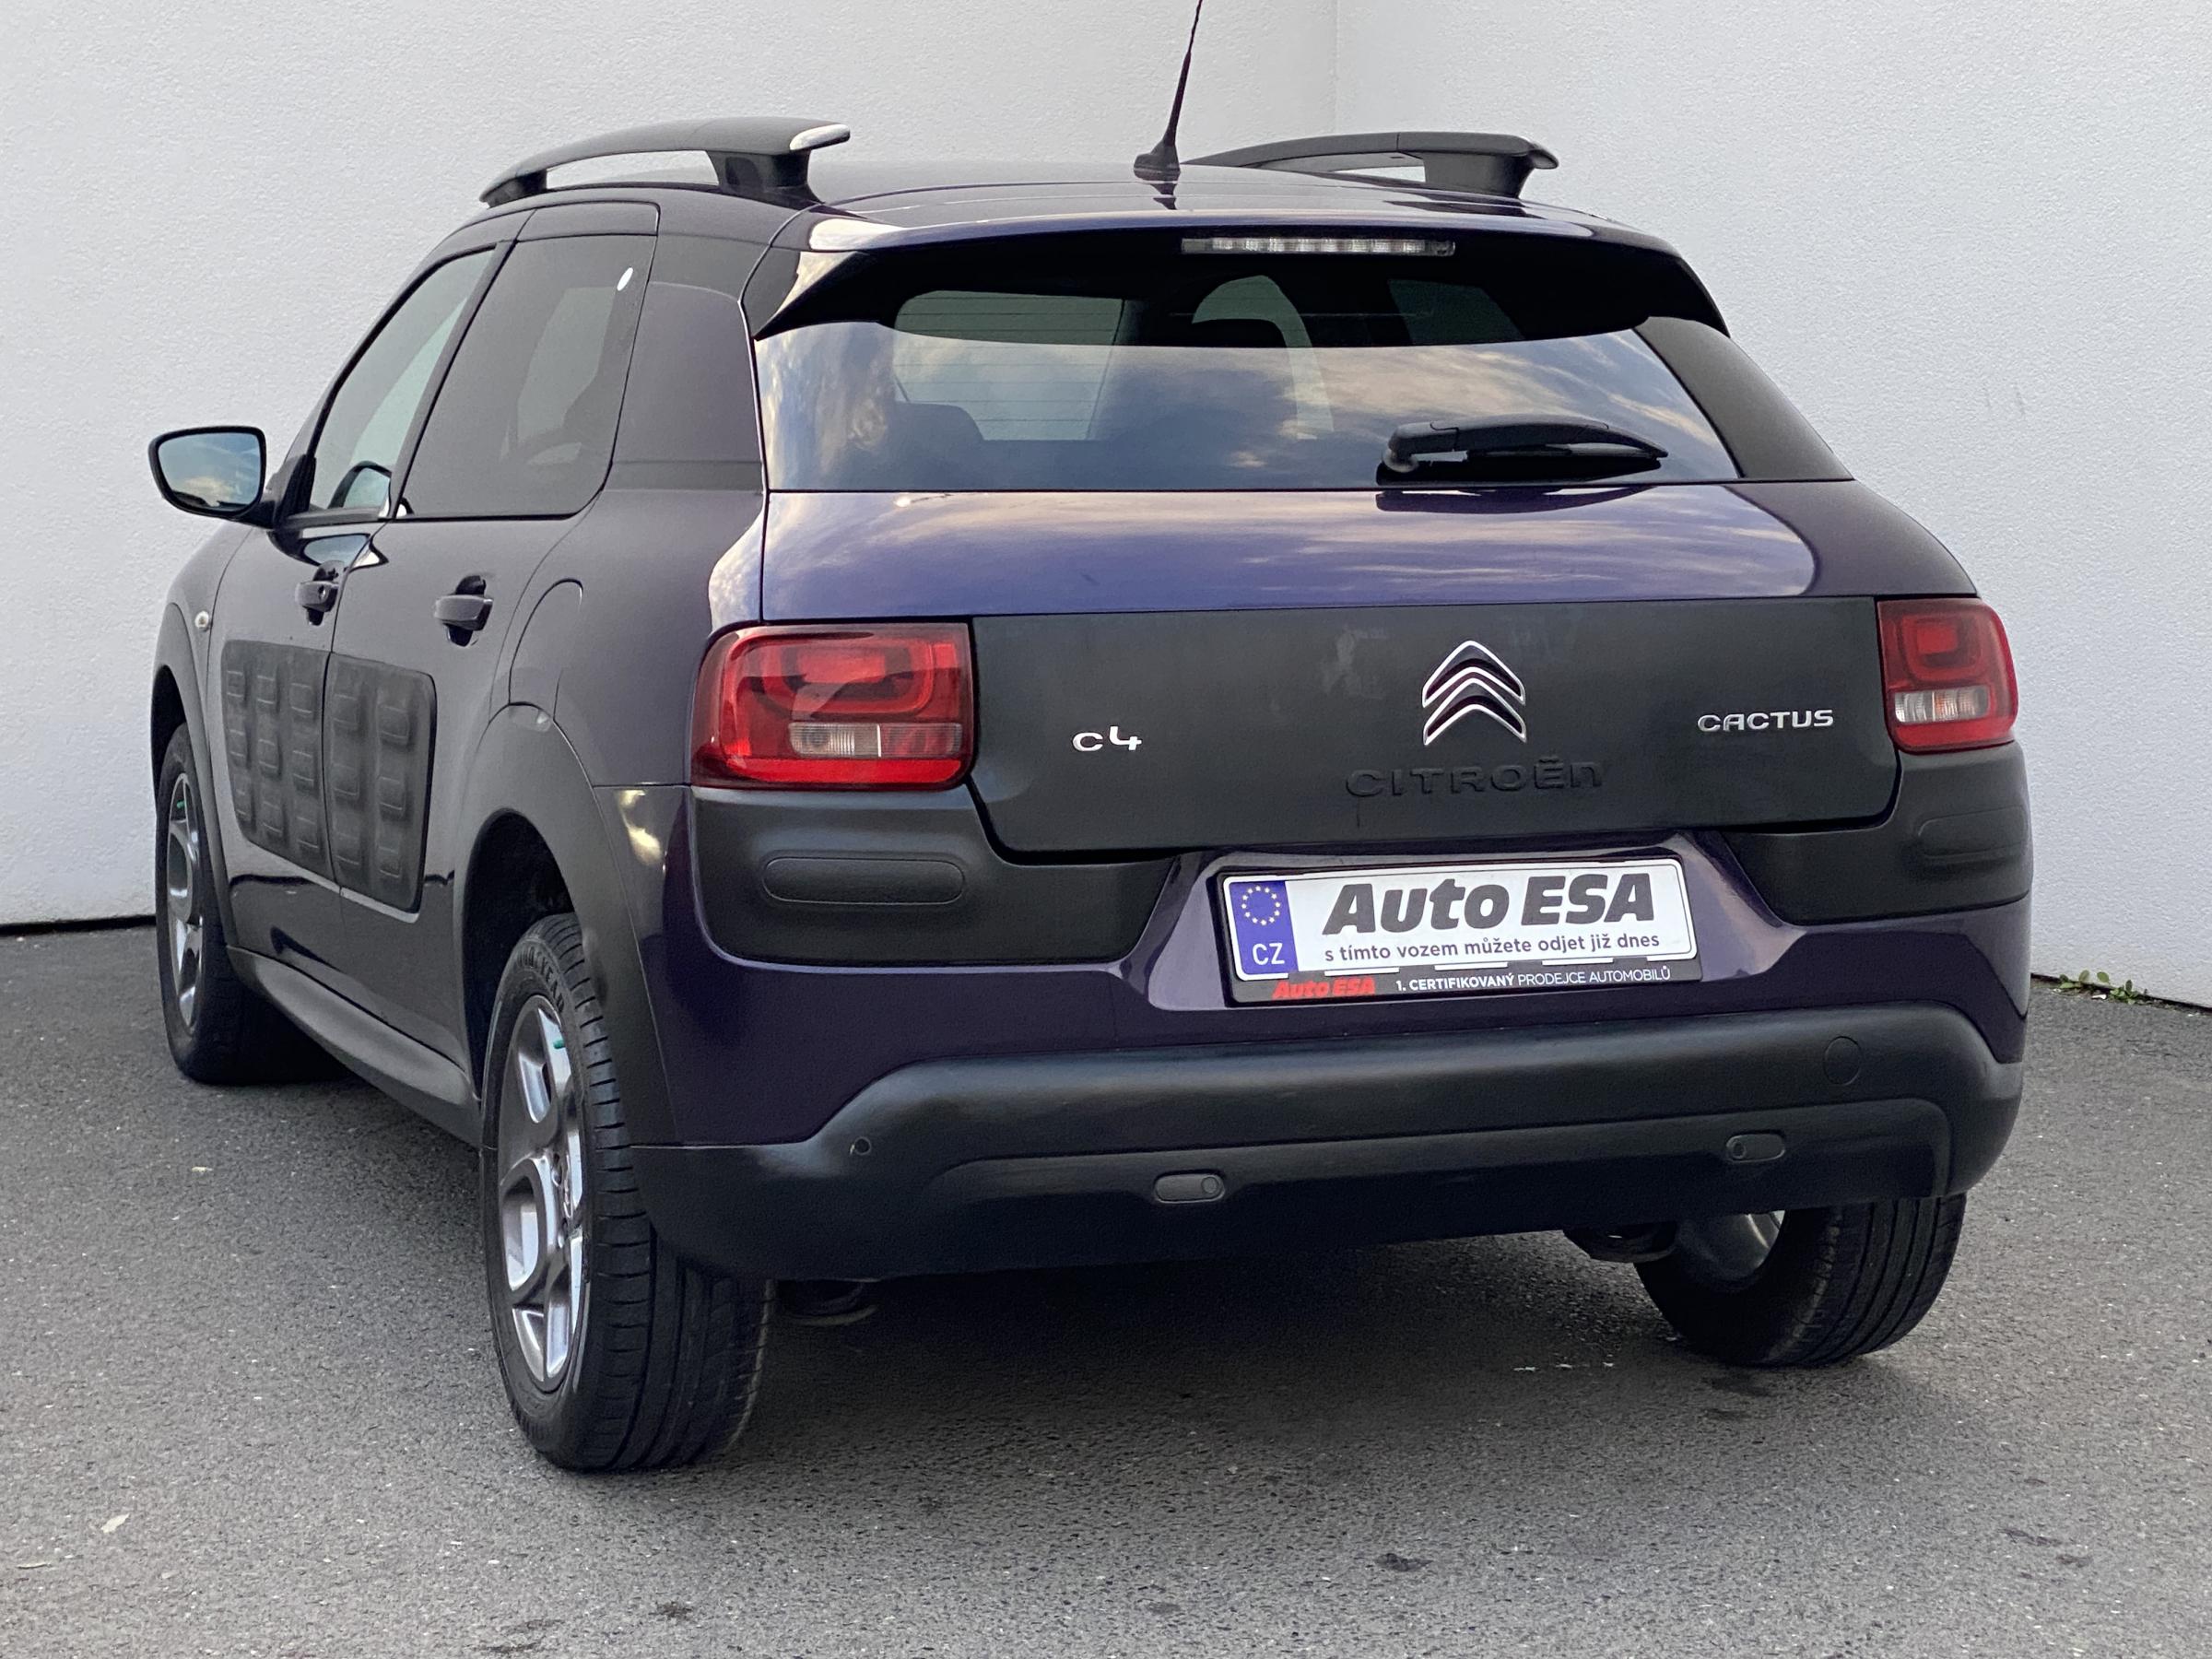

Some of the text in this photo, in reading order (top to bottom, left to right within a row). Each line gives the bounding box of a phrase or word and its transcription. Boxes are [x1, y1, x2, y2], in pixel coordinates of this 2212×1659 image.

[1697, 709, 1834, 733] CACTUS
[1322, 872, 1654, 935] Auto ESA
[1252, 942, 1285, 966] CZ
[1324, 933, 1660, 961] s tímto vozem můžete odjet již dnes
[1273, 977, 1375, 998] Auto ESA
[1396, 965, 1671, 991] 1. CERTIFIKOVANÝ PRODEJCE AUTOMOBILŮ
